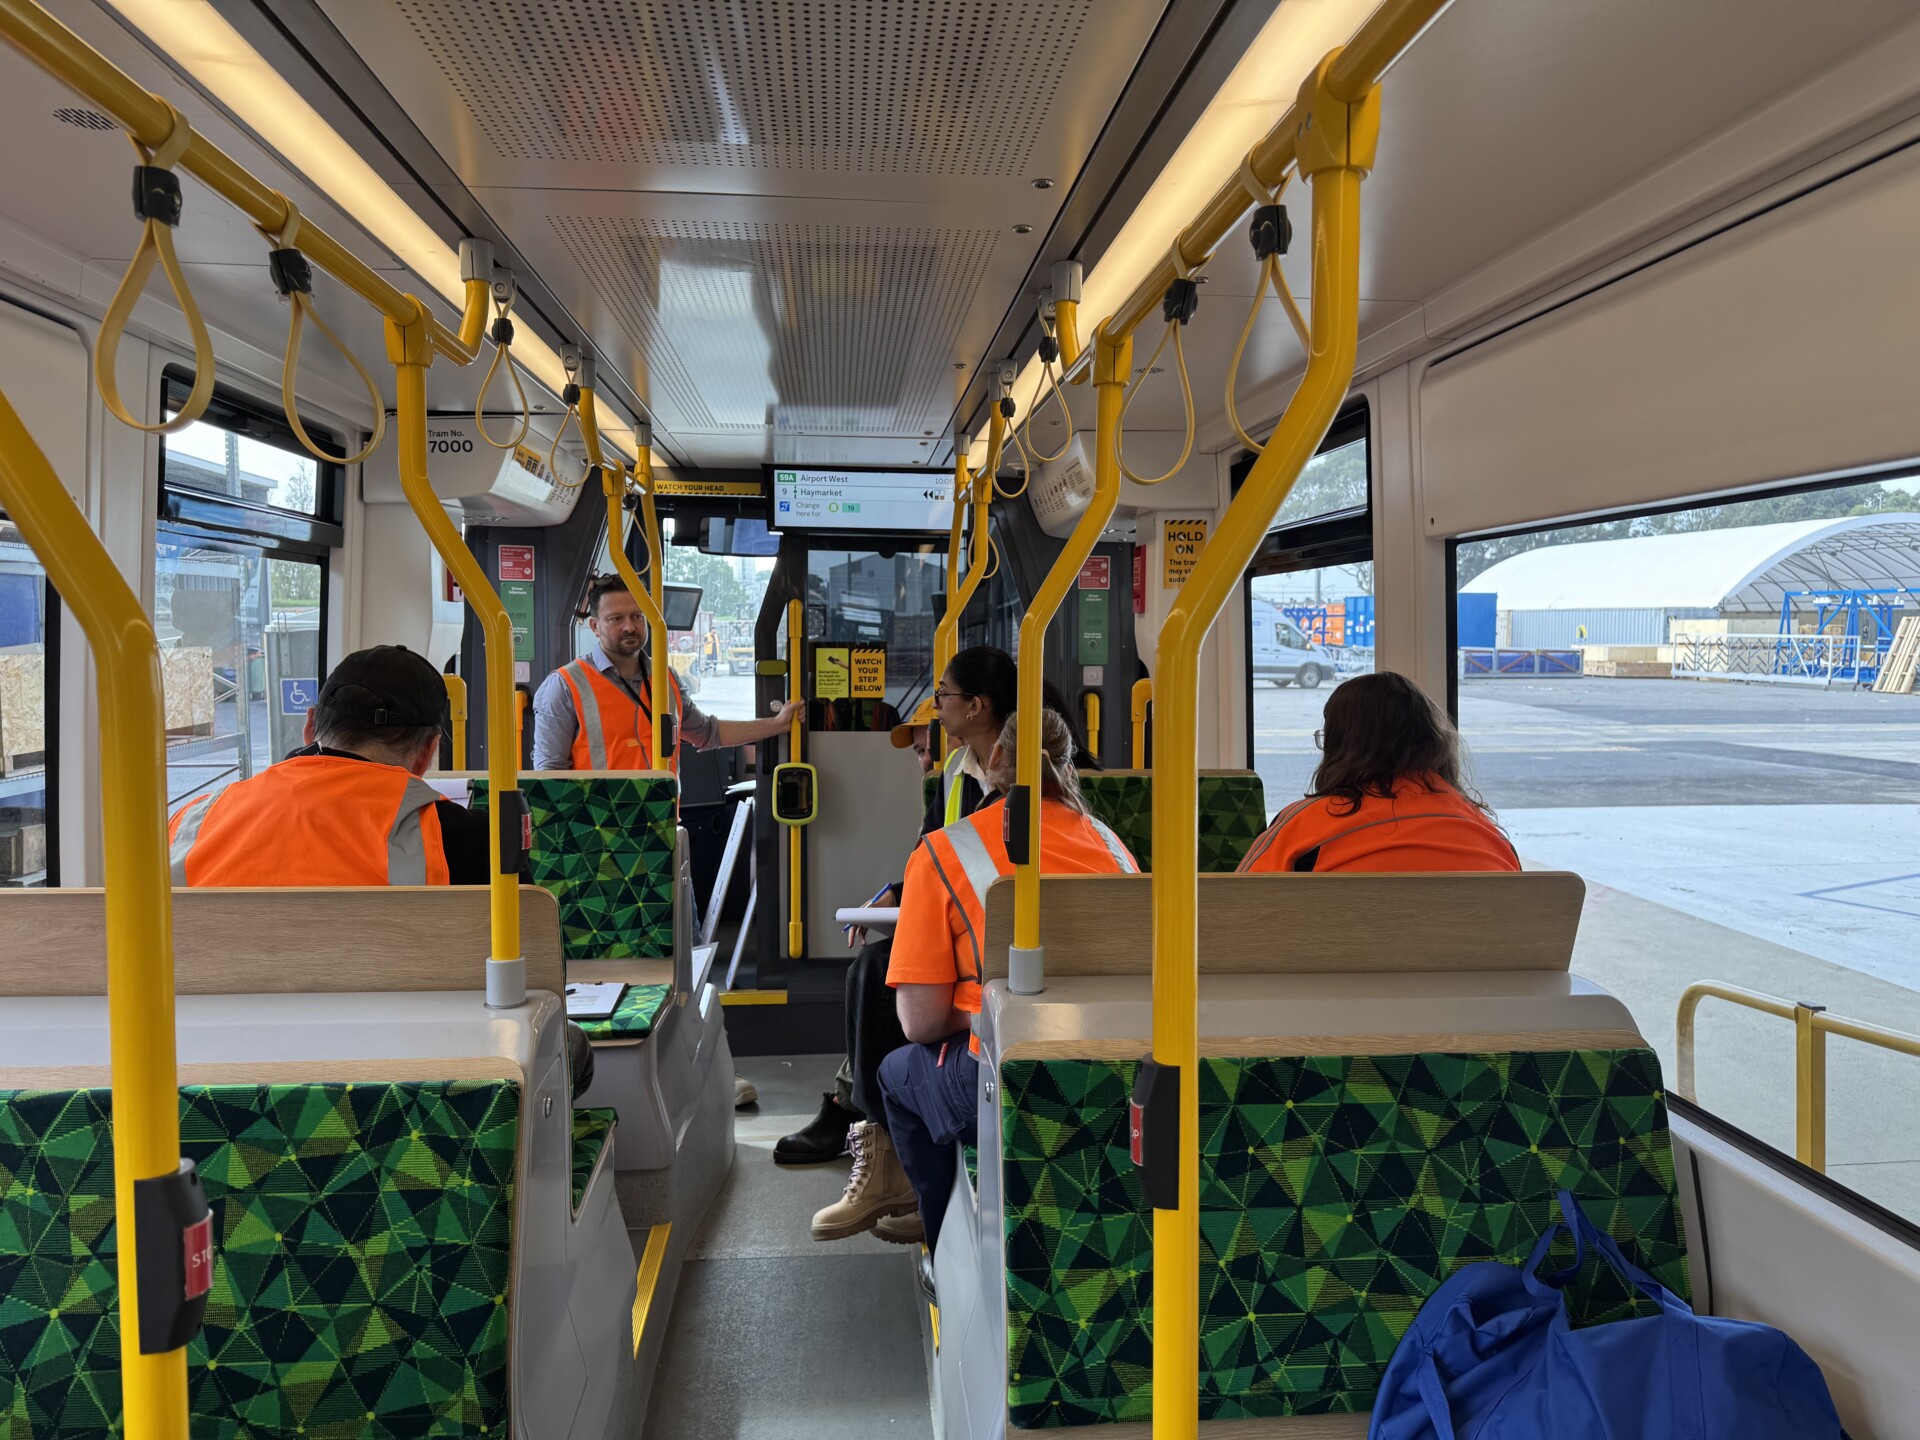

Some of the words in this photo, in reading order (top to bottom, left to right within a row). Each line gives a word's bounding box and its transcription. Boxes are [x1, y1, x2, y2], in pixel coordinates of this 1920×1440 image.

[450, 429, 464, 437] No.
[428, 440, 473, 453] 7000
[800, 474, 828, 484] Airport
[829, 475, 849, 483] West
[800, 488, 842, 498] Haymarket
[796, 501, 820, 510] Change
[1168, 531, 1204, 542] HOLD
[1175, 544, 1194, 554] ON
